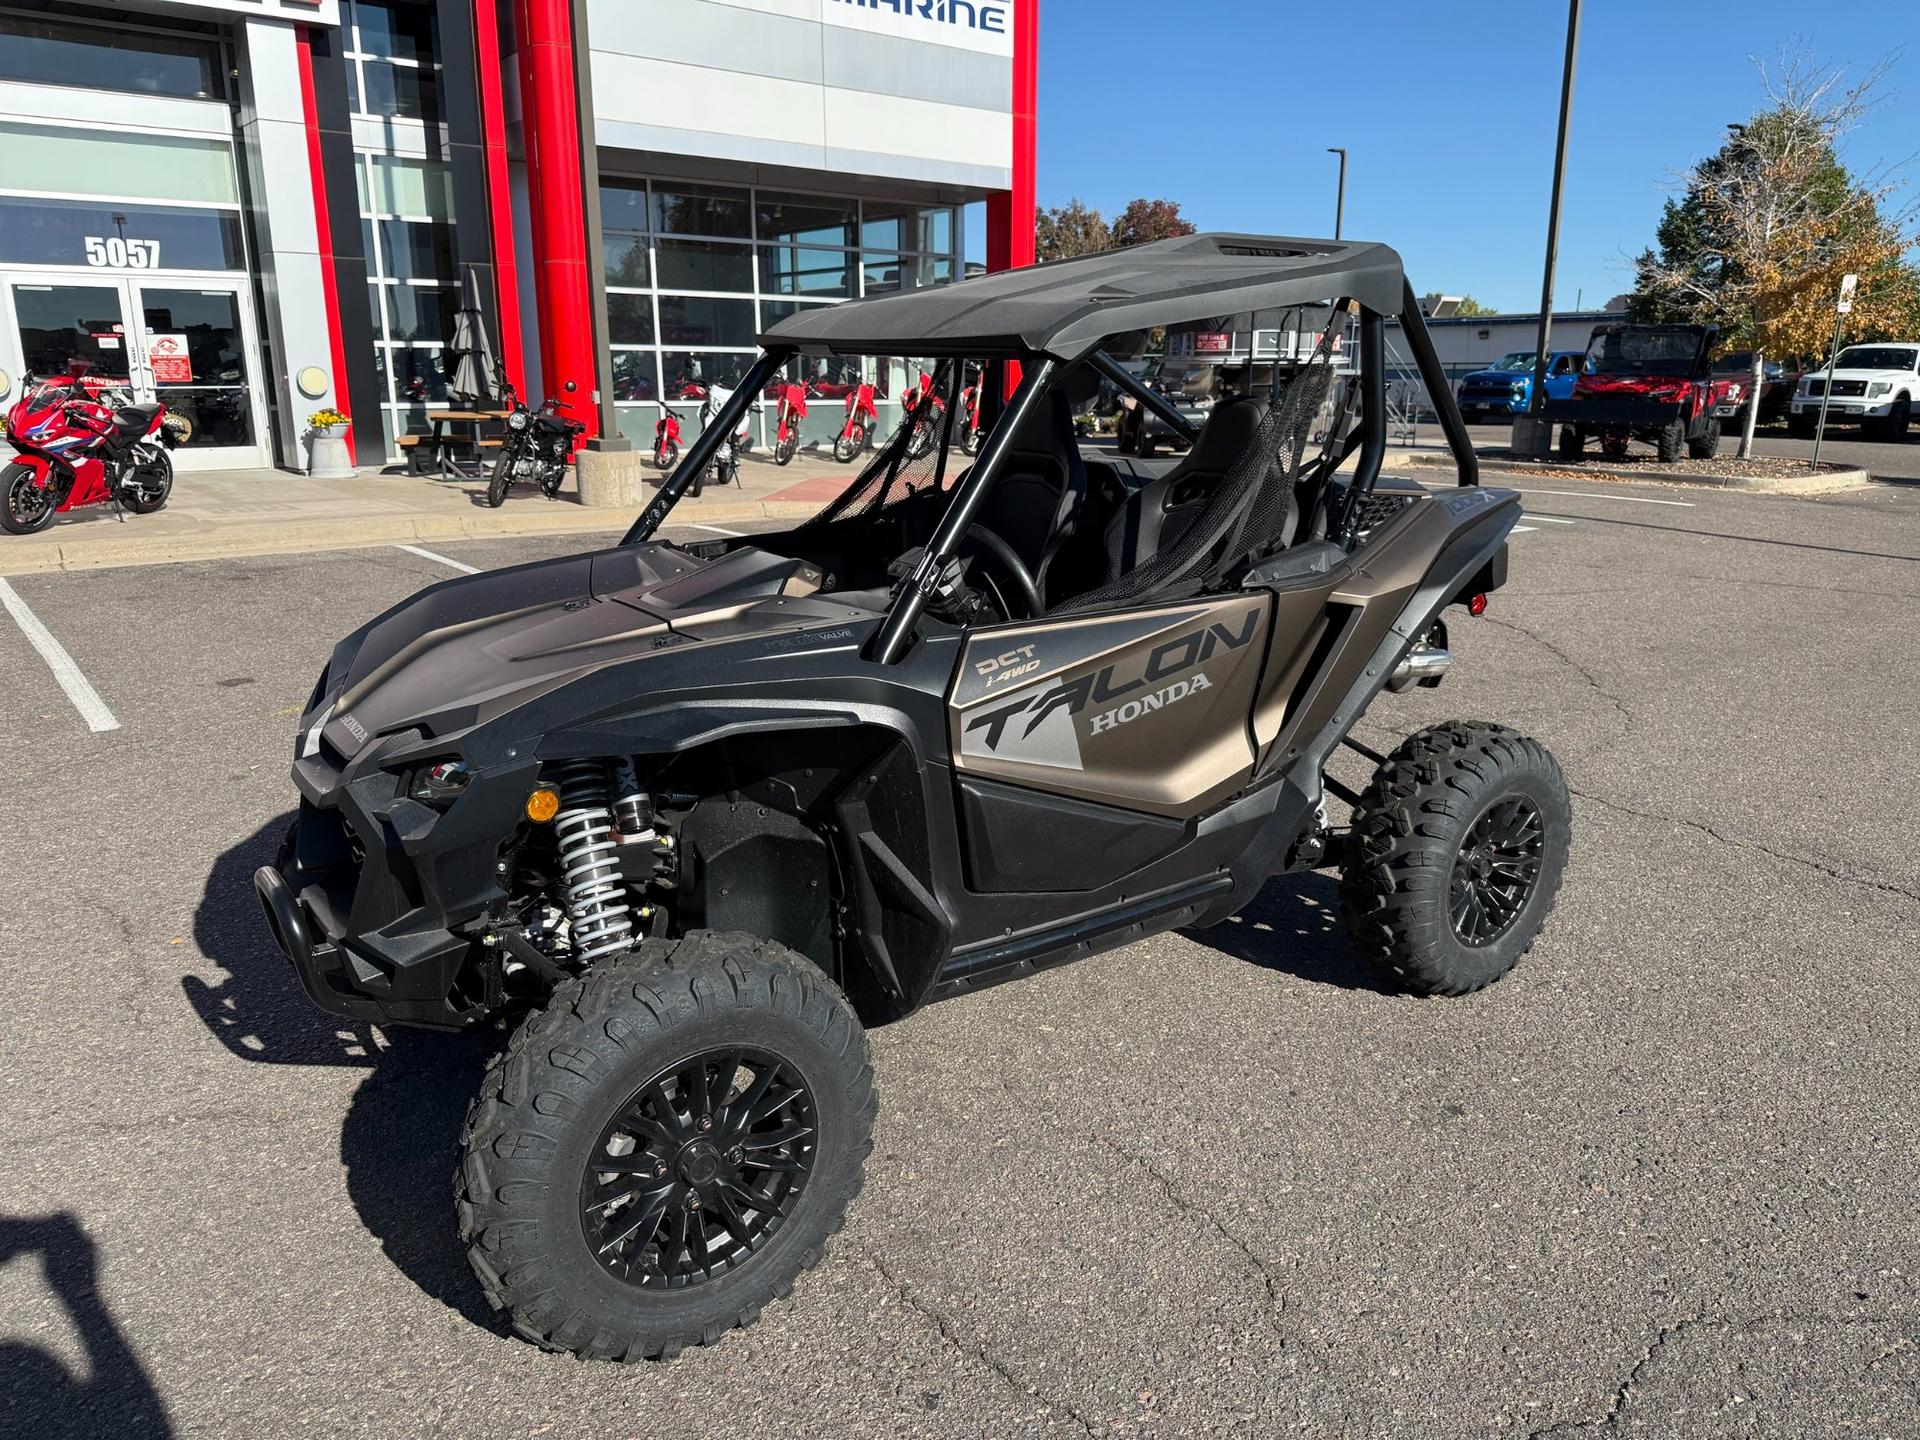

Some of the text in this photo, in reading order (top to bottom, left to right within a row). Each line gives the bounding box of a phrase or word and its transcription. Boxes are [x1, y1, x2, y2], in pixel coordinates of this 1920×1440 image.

[833, 0, 1005, 34] RINE
[84, 236, 160, 269] 5057
[975, 644, 1036, 676] DCT
[985, 659, 1042, 688] i-4WD
[964, 607, 1261, 752] TALON
[1090, 672, 1213, 736] HONDA
[339, 712, 369, 744] HONDA
[614, 752, 640, 794] OX
